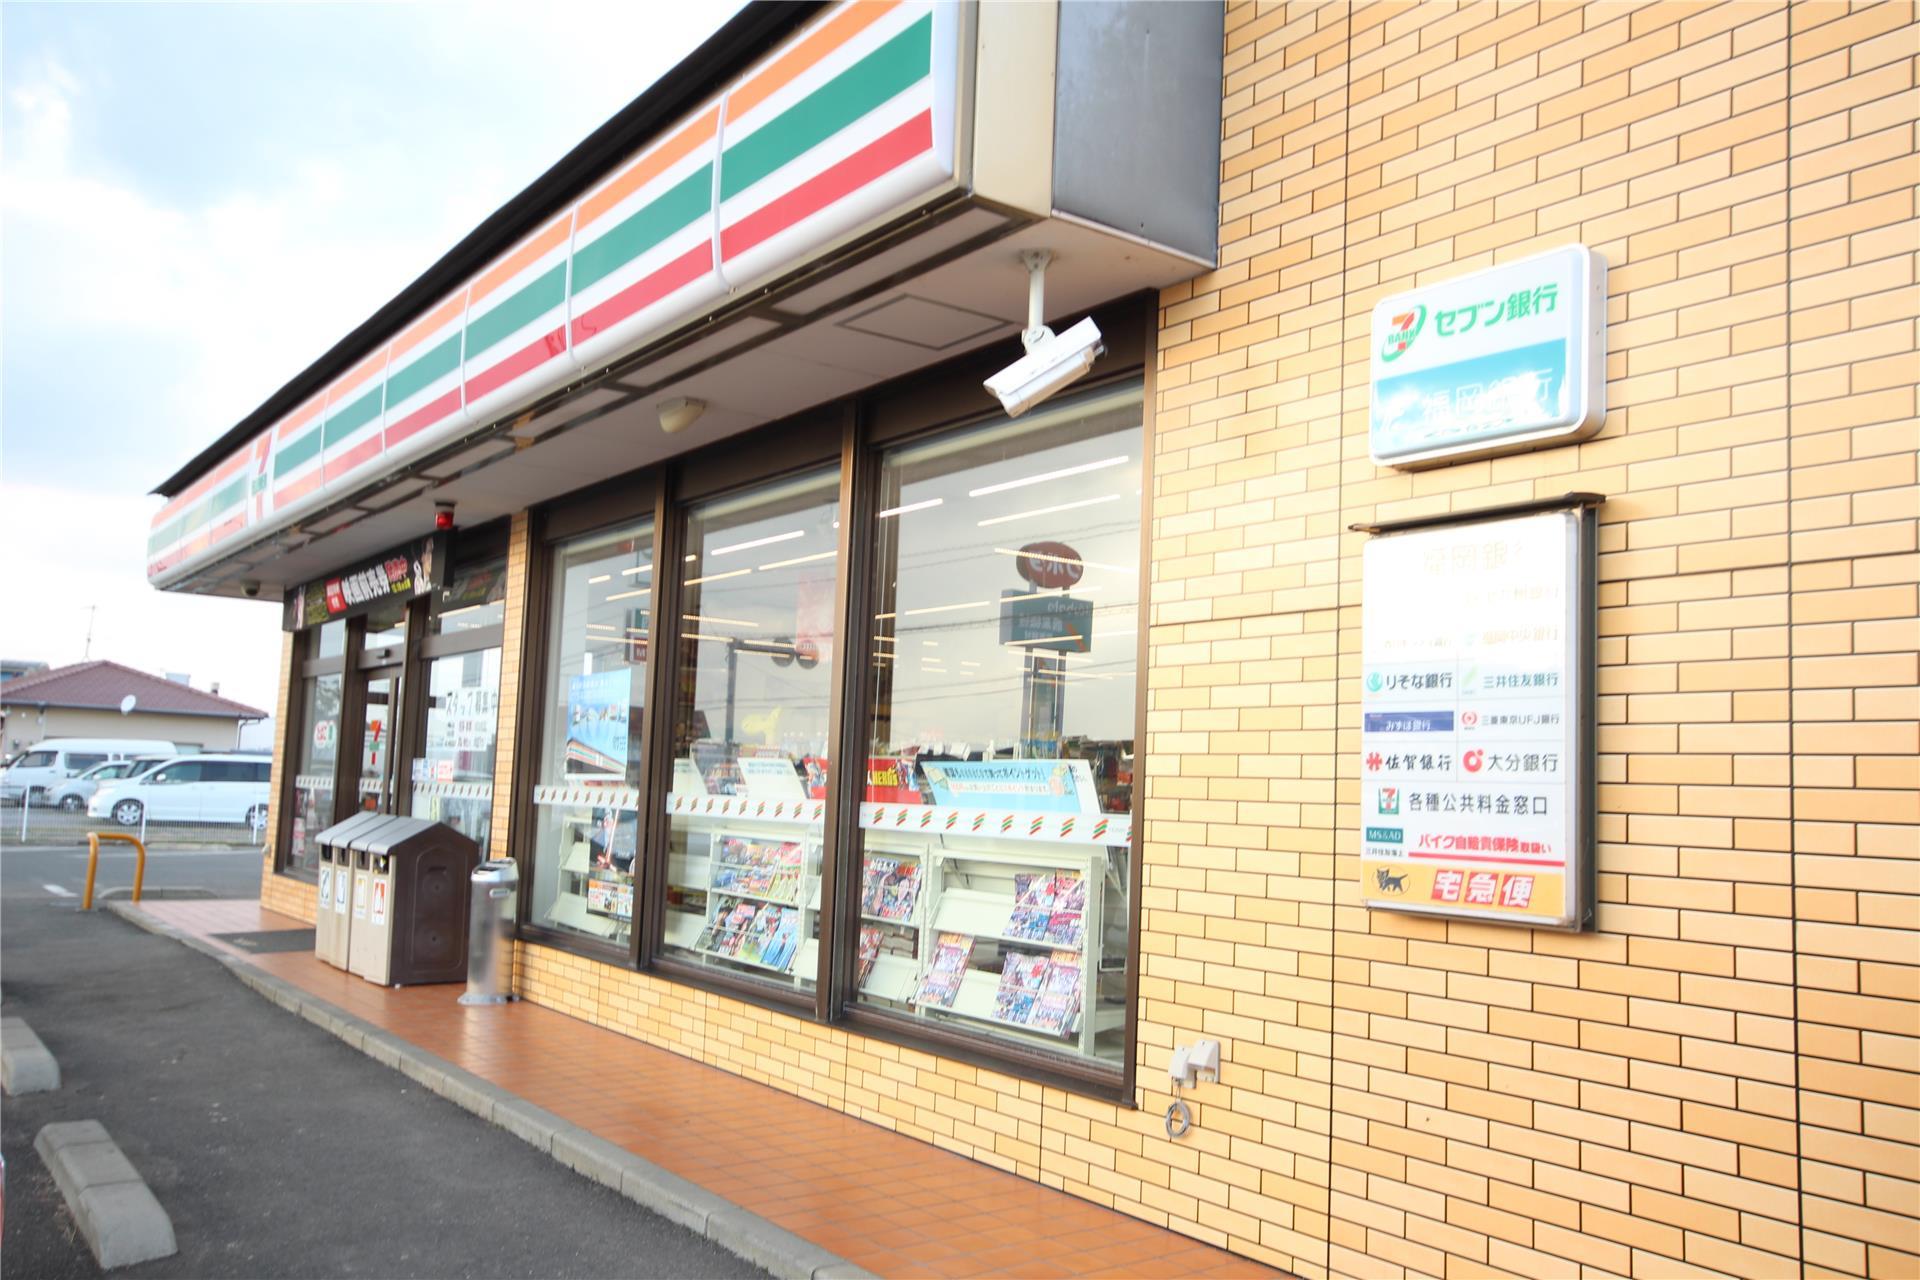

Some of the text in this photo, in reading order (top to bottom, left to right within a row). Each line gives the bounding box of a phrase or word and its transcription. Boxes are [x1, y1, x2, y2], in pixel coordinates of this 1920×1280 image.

[1435, 284, 1558, 337] セブン銀行
[1386, 672, 1453, 690] りそな銀行
[1483, 672, 1559, 689] 三井住友銀行
[1385, 719, 1431, 731] みずほ銀行
[1482, 713, 1559, 726] 三菱東京UFJ銀行
[1385, 754, 1452, 771] 佐賀銀行
[1488, 754, 1559, 772] 大分銀行
[1409, 792, 1548, 816] 各種公共料金窓口
[1369, 830, 1402, 842] MS&AD
[1436, 871, 1534, 907] 宅急便
